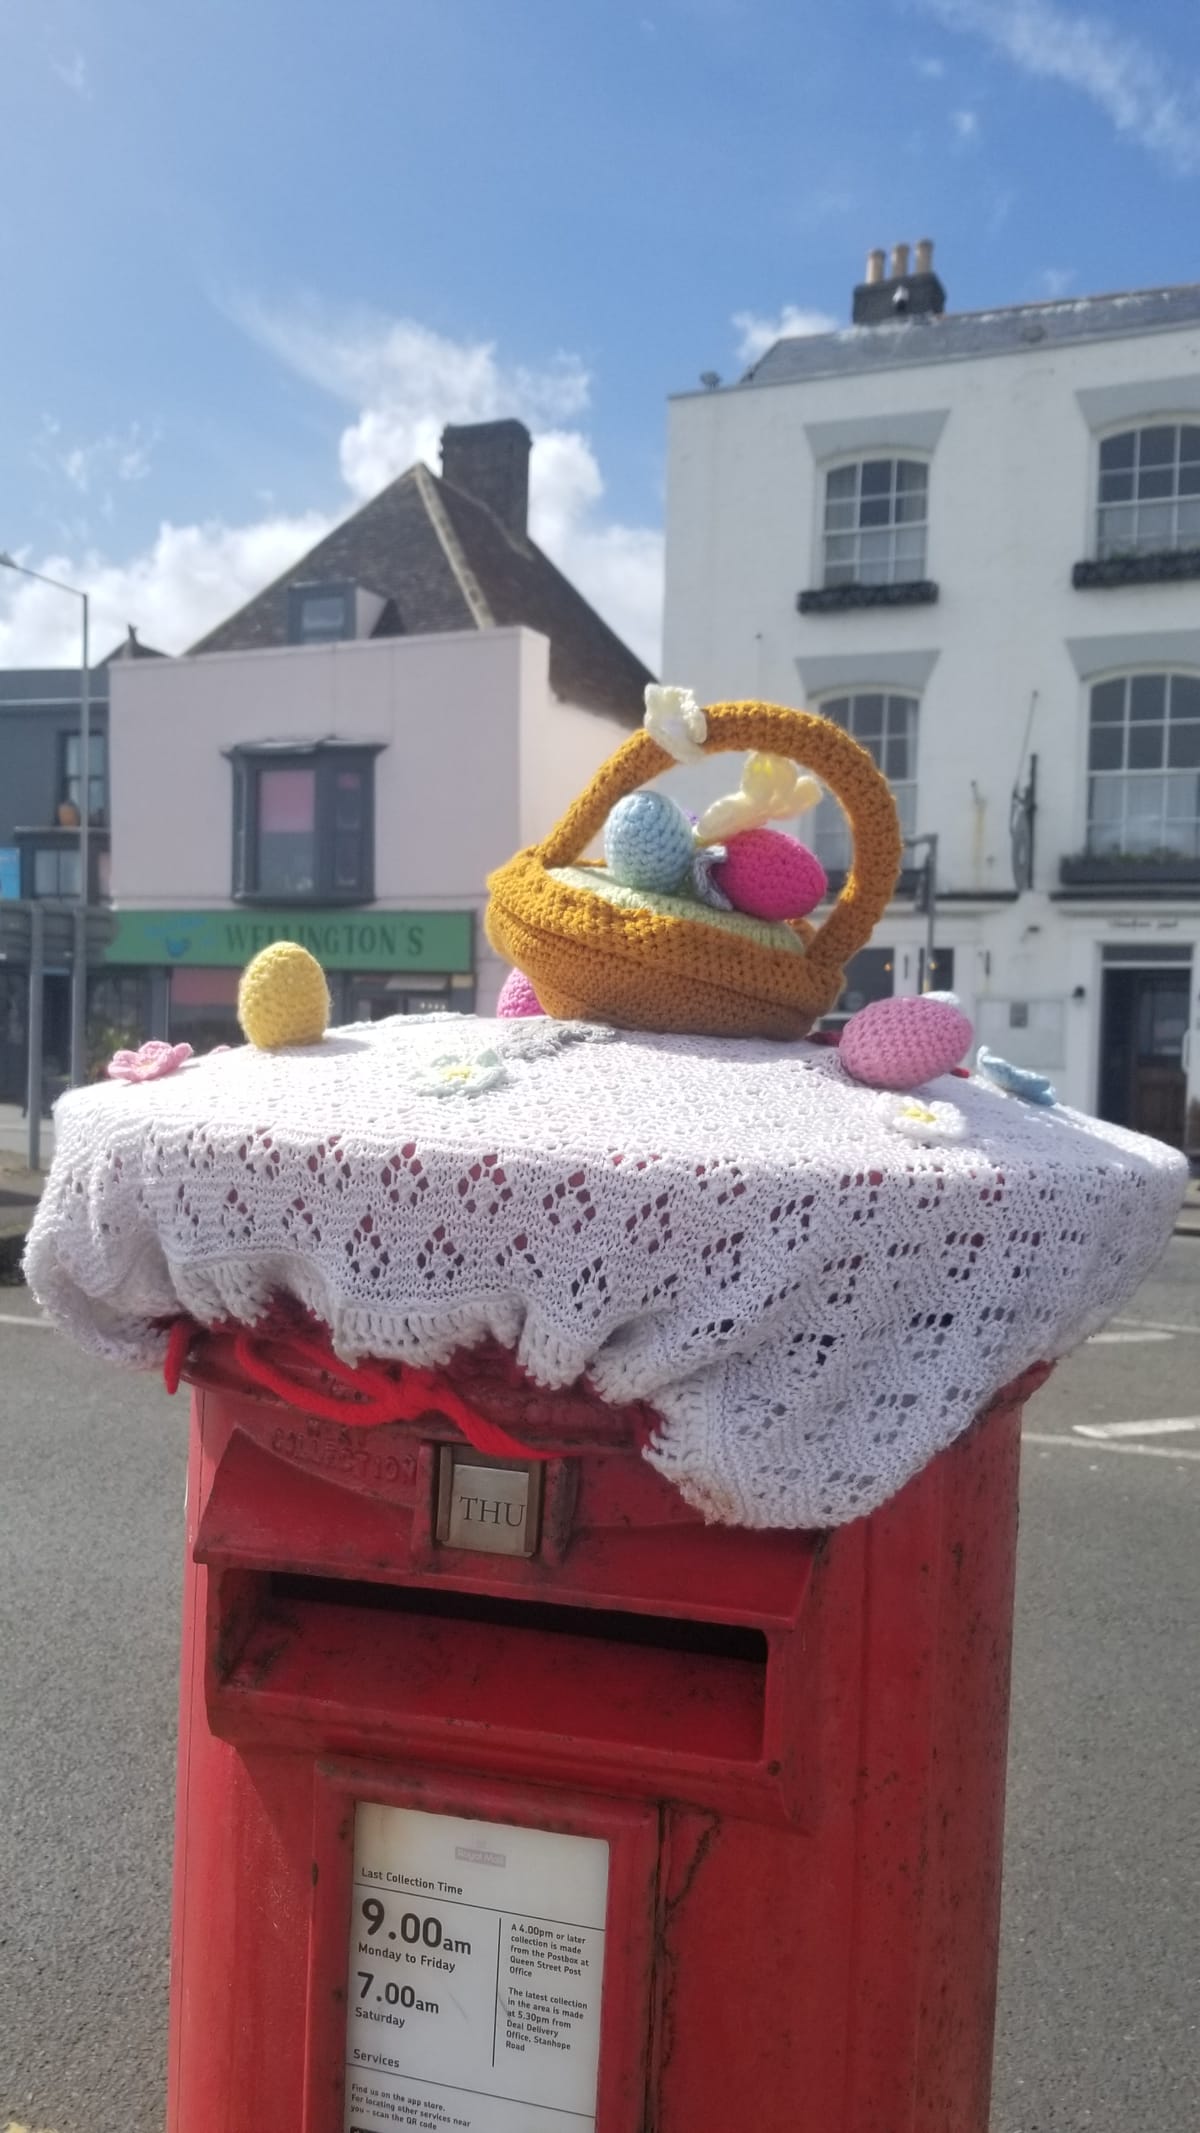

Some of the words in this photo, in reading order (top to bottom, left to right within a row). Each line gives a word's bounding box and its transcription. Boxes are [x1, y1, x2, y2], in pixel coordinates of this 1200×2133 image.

[458, 1495, 526, 1528] THU
[361, 1867, 383, 1880] Last
[386, 1871, 435, 1890] Collection
[438, 1881, 463, 1895] Time
[362, 1898, 471, 1955] 9.00am
[511, 1923, 517, 1931] A
[519, 1924, 553, 1938] 4.00pm
[567, 1934, 586, 1944] later
[510, 1944, 529, 1955] from
[532, 1949, 545, 1958] the
[547, 1951, 578, 1965] Postbox
[581, 1959, 589, 1967] at
[511, 1935, 548, 1949] collection
[551, 1941, 557, 1950] is
[560, 1945, 582, 1954] made
[358, 1942, 401, 1962] Monday
[406, 1953, 416, 1963] to
[420, 1955, 455, 1973] Friday
[510, 1955, 534, 1967] Queen
[537, 1960, 561, 1973] Street
[564, 1965, 582, 1976] Post
[509, 1966, 532, 1977] Office
[357, 1971, 439, 2014] 7.00am
[509, 1987, 523, 1996] The
[525, 1990, 548, 2001] latest
[550, 1996, 588, 2009] collection
[355, 2007, 405, 2028] Saturday
[507, 1997, 515, 2006] in
[518, 1999, 530, 2009] the
[533, 2004, 550, 2013] area
[553, 2006, 559, 2014] is
[562, 2010, 584, 2020] made
[507, 2010, 516, 2018] at
[518, 2011, 549, 2024] 5.30pm
[552, 2018, 571, 2028] from
[506, 2019, 524, 2030] Deal
[526, 2023, 559, 2038] Delivery
[506, 2030, 531, 2042] Office,
[534, 2035, 571, 2050] Stanhope
[506, 2040, 525, 2051] Road
[353, 2048, 400, 2068] Services
[351, 2083, 368, 2093] Find
[393, 2093, 405, 2102] the
[407, 2097, 421, 2106] app
[350, 2105, 364, 2113] you
[372, 2109, 389, 2118] scan
[391, 2112, 404, 2122] the
[406, 2116, 417, 2126] QR
[420, 2121, 437, 2130] code
[351, 2094, 363, 2103] For
[366, 2096, 395, 2111] locating
[397, 2104, 418, 2115] other
[420, 2110, 451, 2123] services
[453, 2118, 471, 2127] near
